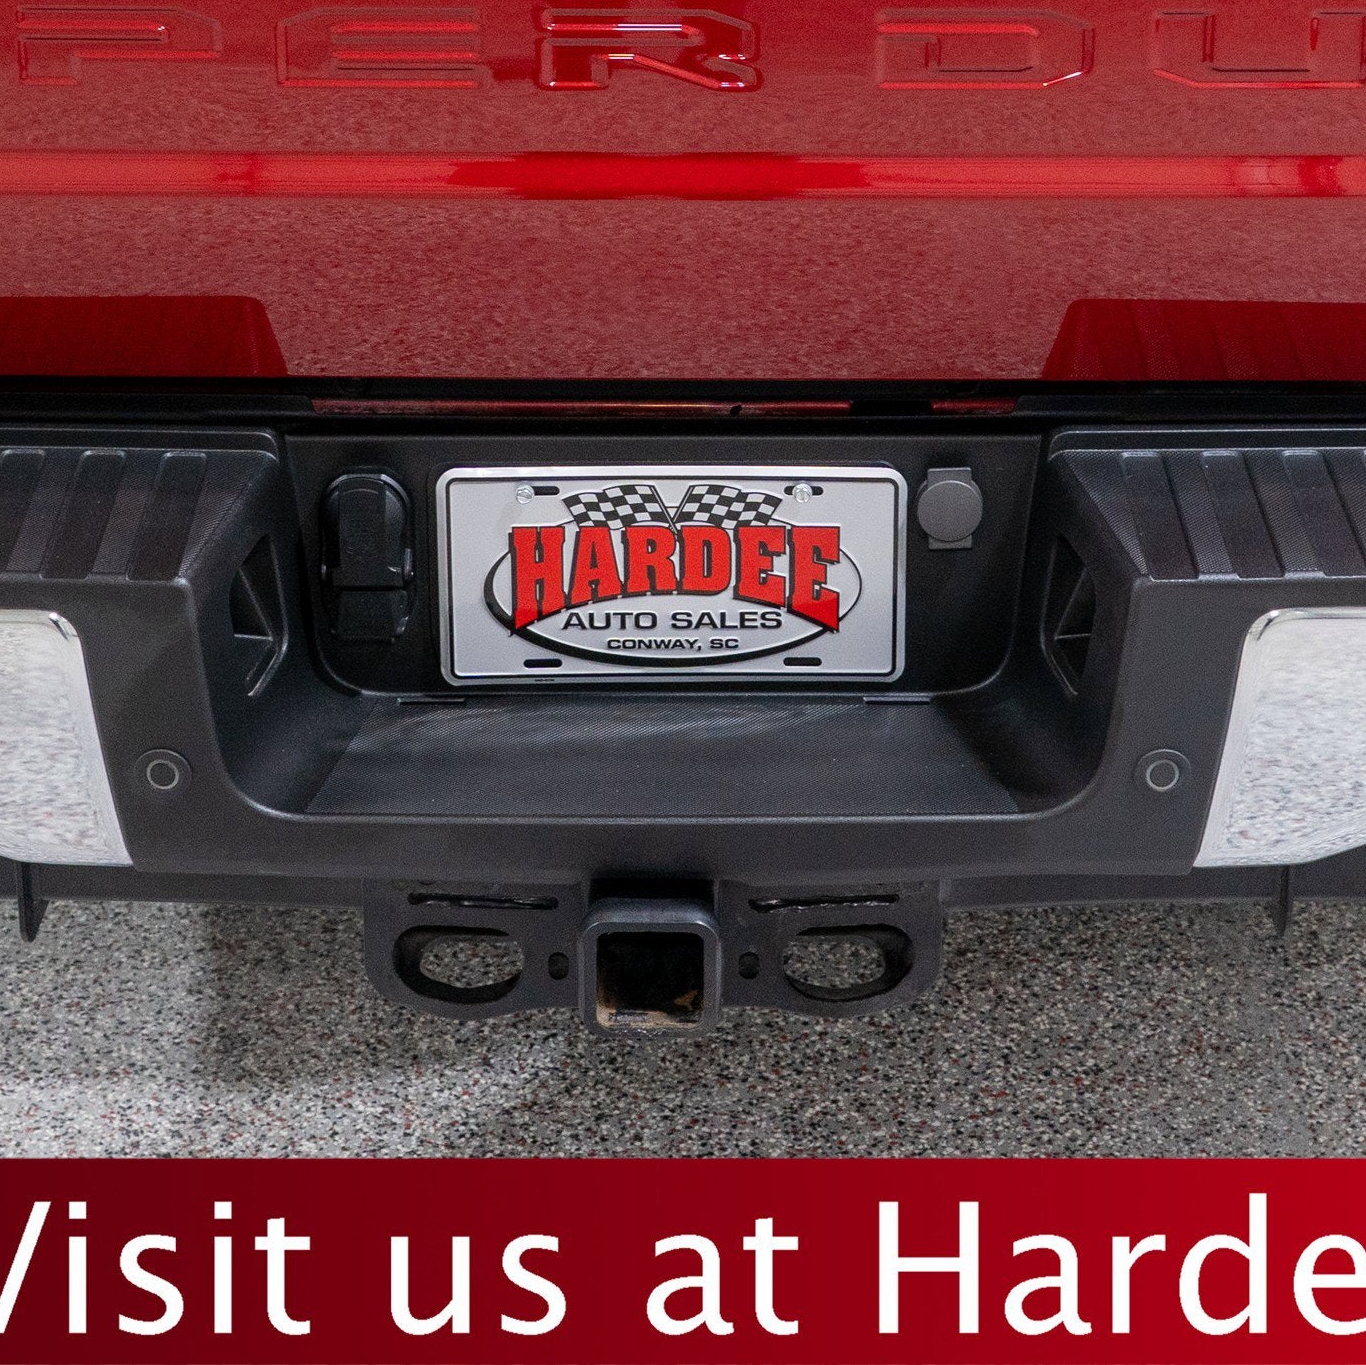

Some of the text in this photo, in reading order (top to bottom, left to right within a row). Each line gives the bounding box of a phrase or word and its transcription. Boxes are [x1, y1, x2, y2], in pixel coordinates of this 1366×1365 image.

[508, 524, 840, 636] HARDEE
[561, 610, 783, 631] AUTO SALES
[606, 637, 740, 652] CONWAY, SC
